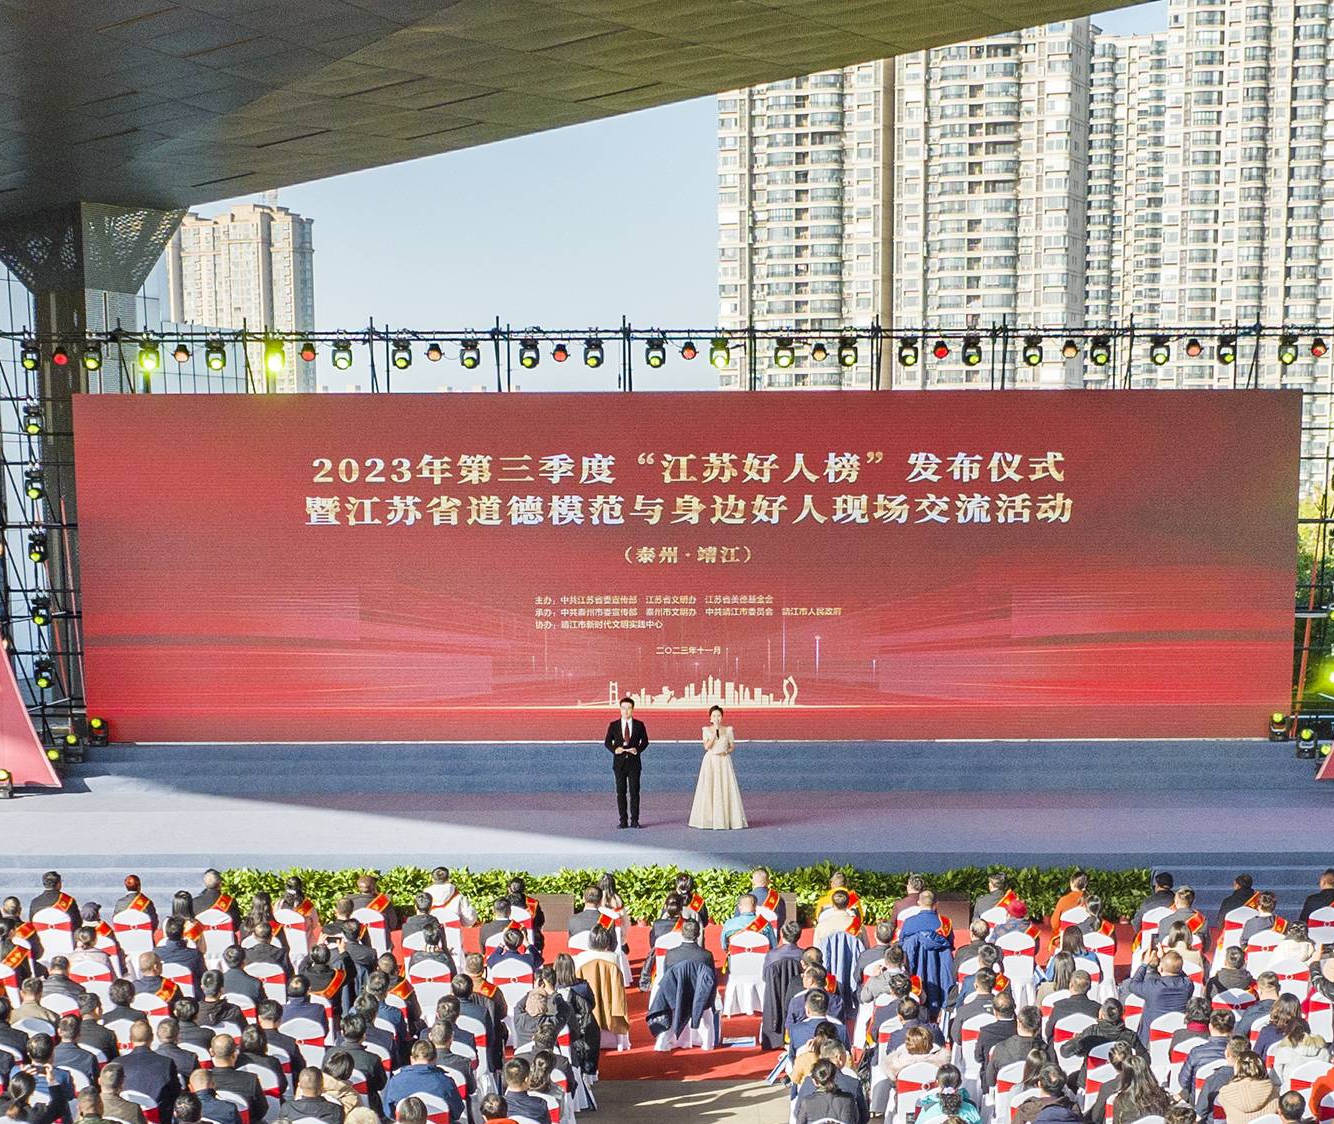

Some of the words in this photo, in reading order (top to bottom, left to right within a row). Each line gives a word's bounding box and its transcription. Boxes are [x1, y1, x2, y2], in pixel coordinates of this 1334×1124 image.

[305, 494, 1074, 526] 暨江苏省道德模范与身边好人现场交流活动
